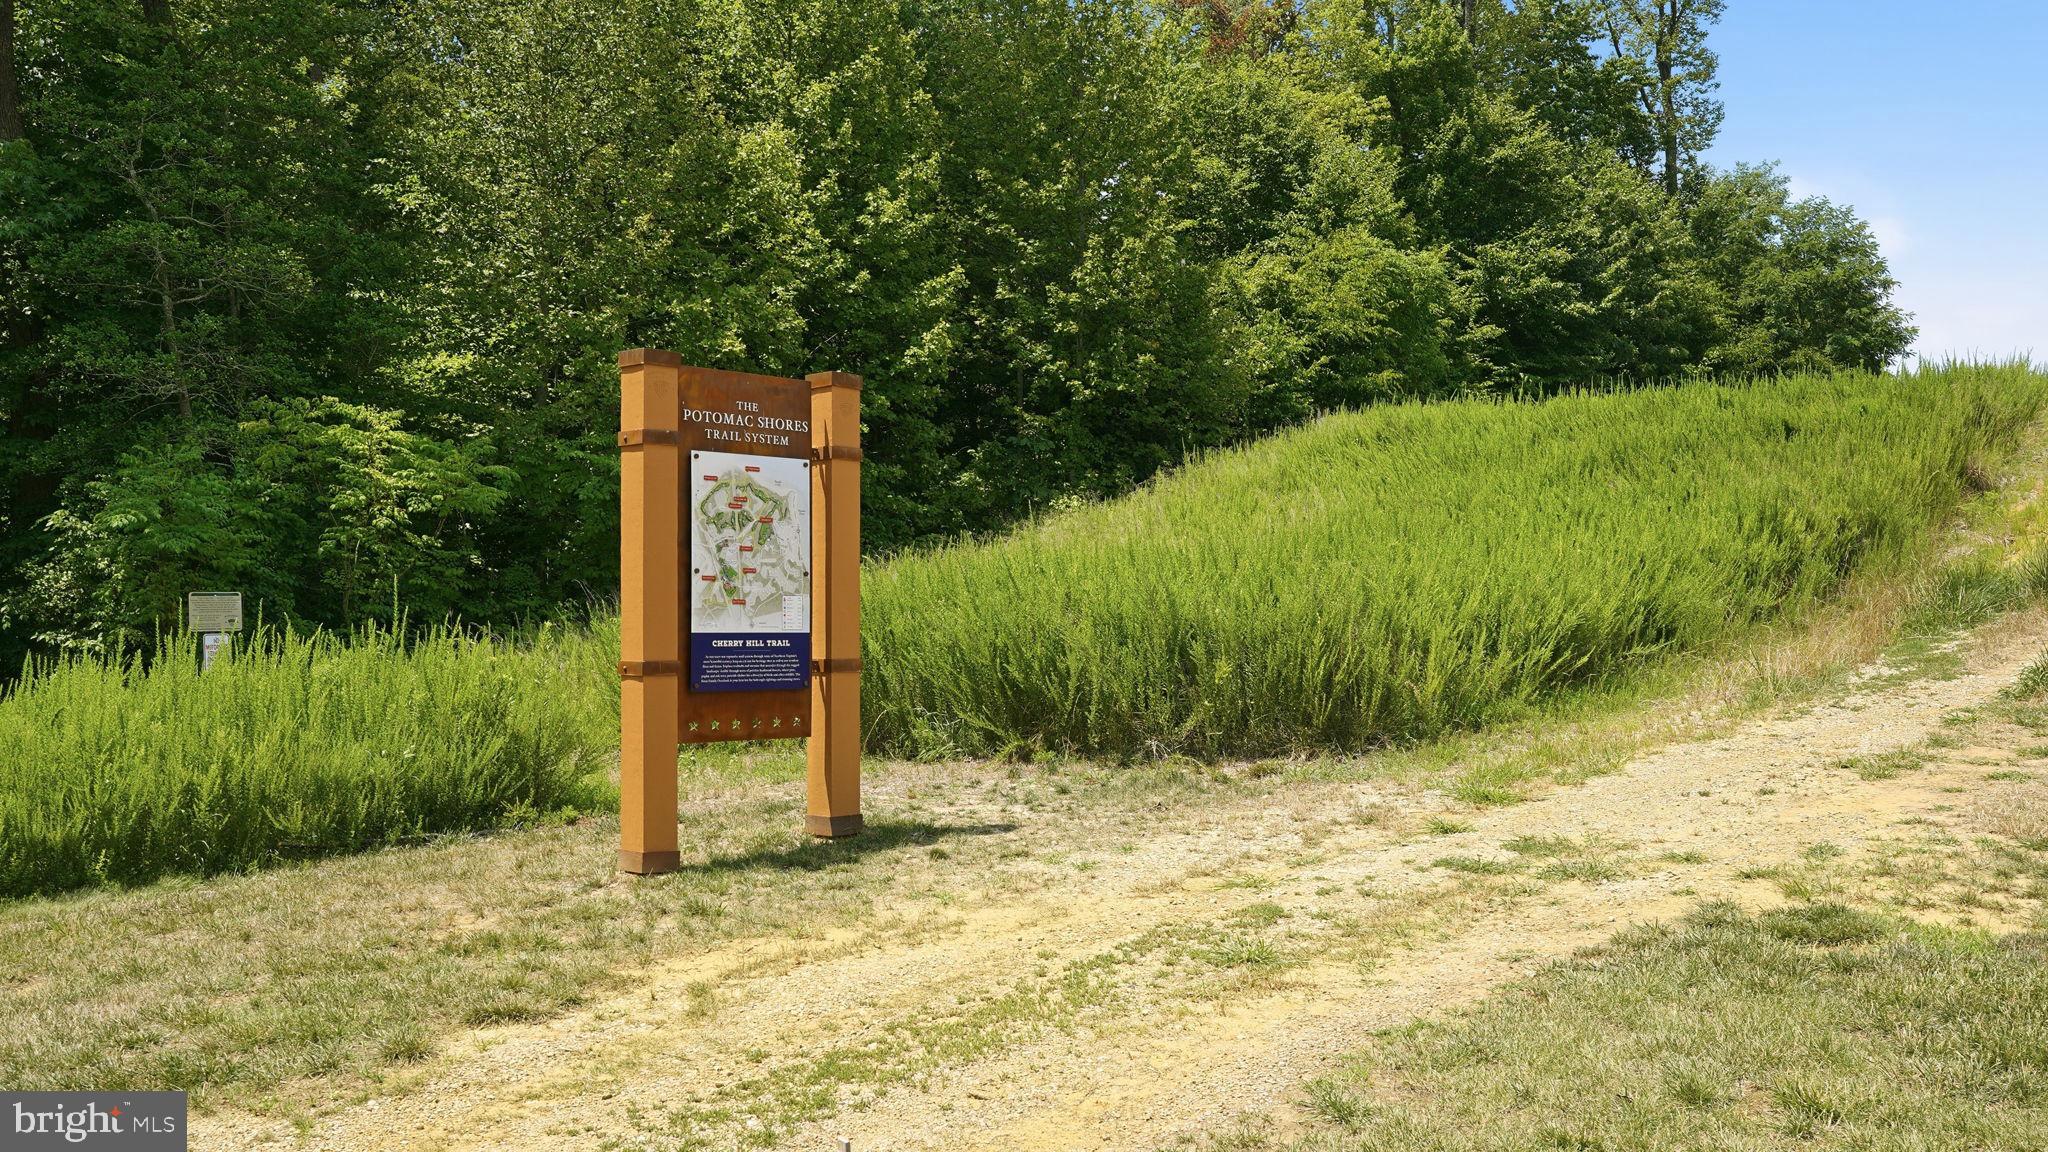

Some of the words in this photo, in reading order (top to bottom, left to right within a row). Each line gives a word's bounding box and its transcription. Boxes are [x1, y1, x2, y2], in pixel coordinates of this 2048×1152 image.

[736, 400, 759, 412] THE
[683, 408, 754, 427] POTOMAC
[757, 416, 809, 433] SHORES
[704, 428, 742, 442] TRAIL
[744, 431, 789, 446] SYSTEM
[712, 639, 744, 647] CHERRY
[745, 639, 765, 647] HILL
[766, 639, 791, 647] TRAIL
